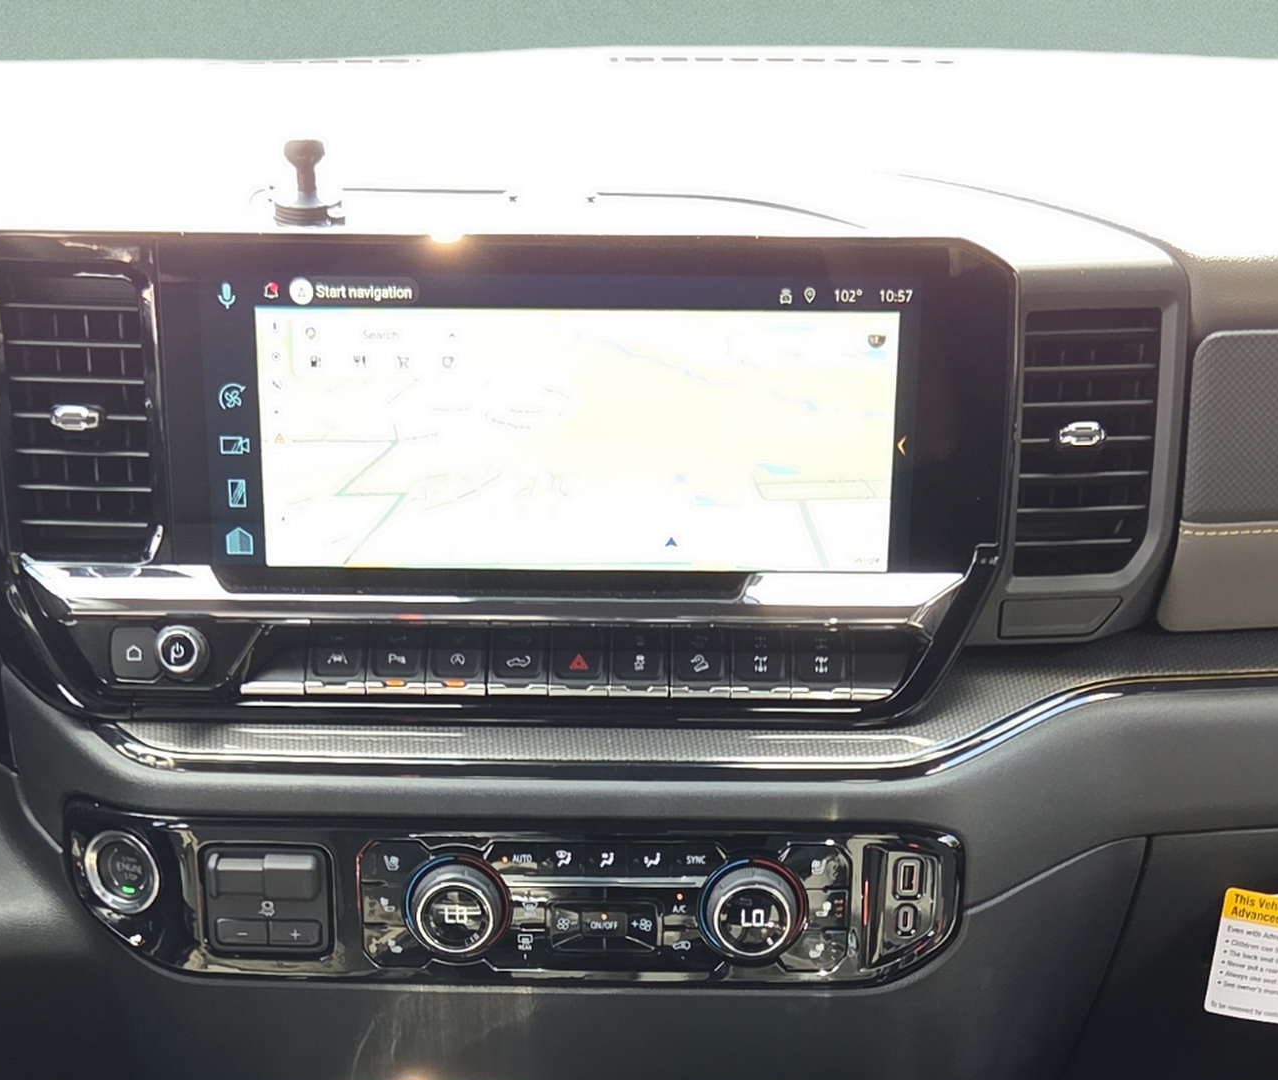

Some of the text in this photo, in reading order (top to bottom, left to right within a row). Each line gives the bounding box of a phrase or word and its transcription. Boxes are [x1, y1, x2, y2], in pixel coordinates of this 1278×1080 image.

[315, 285, 413, 302] Start navigation
[834, 289, 863, 302] 102°
[879, 289, 913, 303] 10:57
[512, 854, 533, 863] AUTO
[685, 855, 706, 865] SYNC
[1234, 894, 1255, 907] This
[672, 905, 686, 913] A/C
[741, 909, 764, 927] LO
[590, 921, 618, 930] ON/OFF
